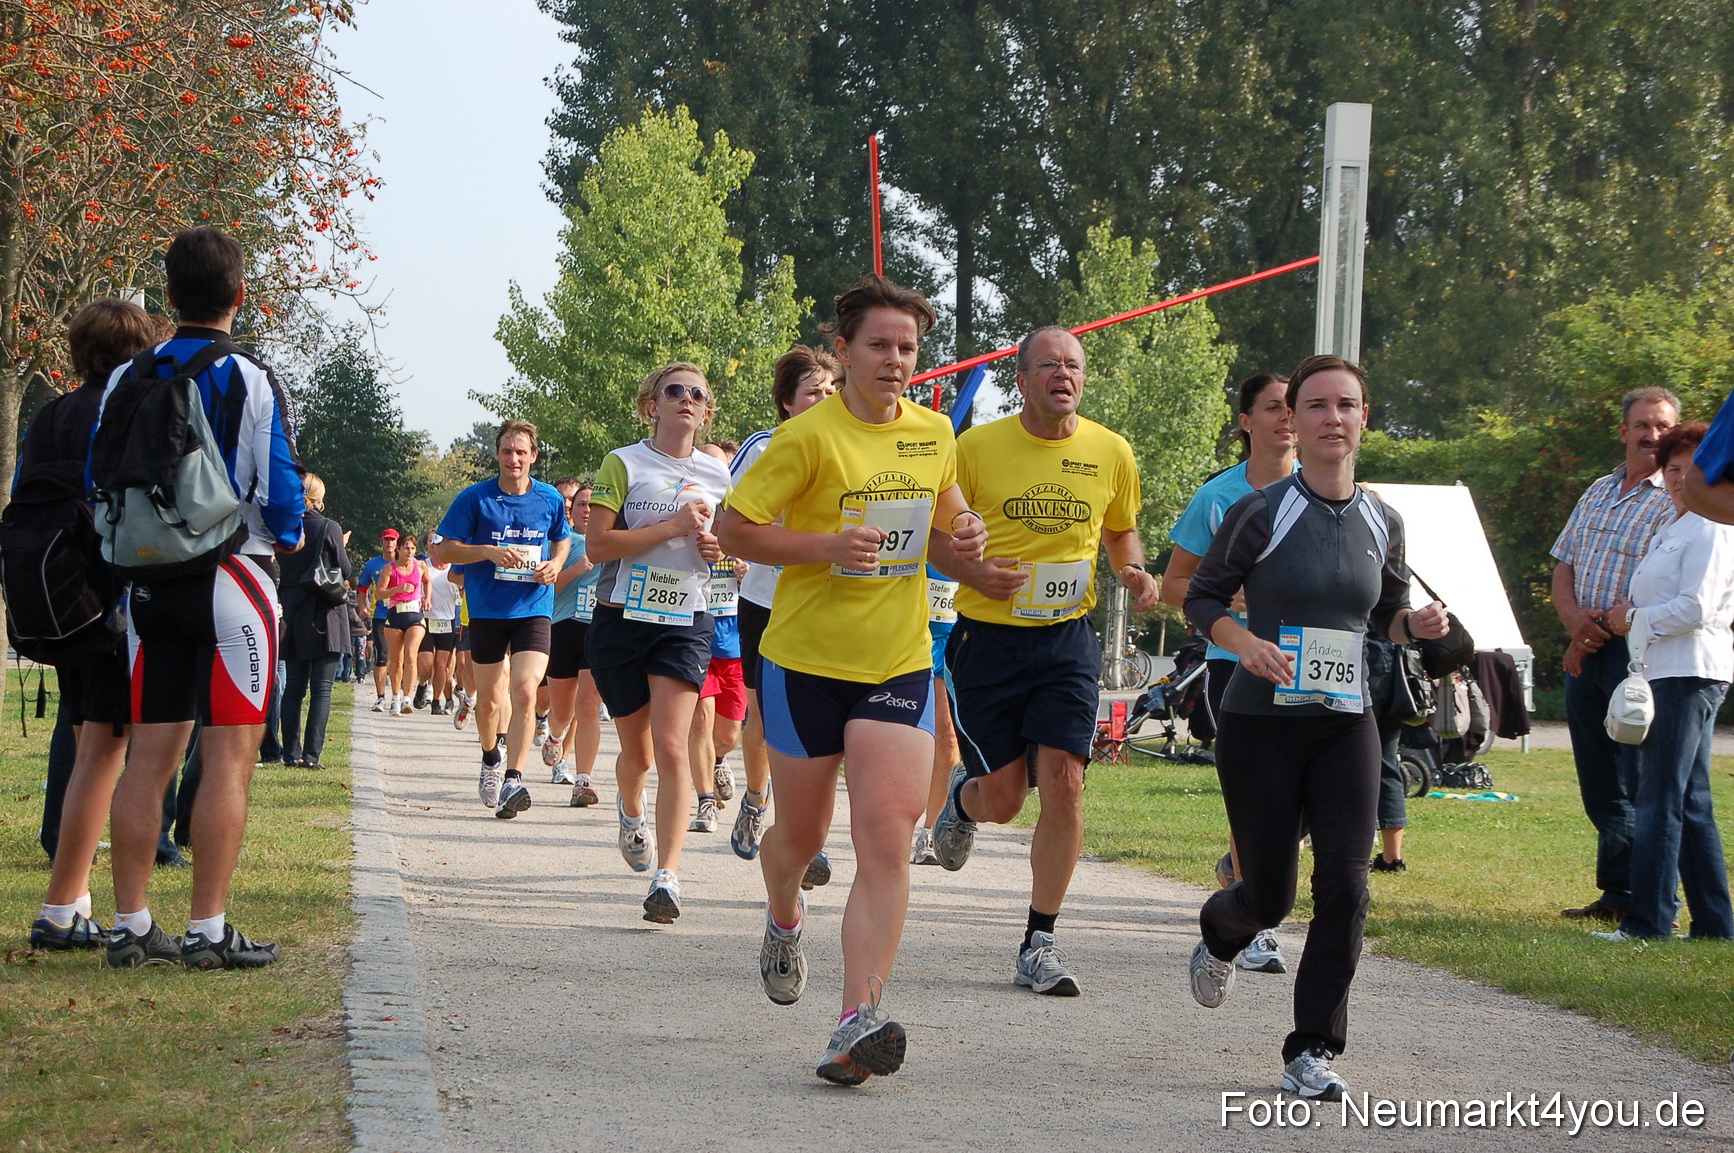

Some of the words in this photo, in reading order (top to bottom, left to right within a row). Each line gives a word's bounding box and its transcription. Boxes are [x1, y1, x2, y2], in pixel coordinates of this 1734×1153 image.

[866, 474, 917, 492] PIZZERIA
[1024, 486, 1074, 501] PIZZERIA
[626, 500, 679, 513] metropol
[1014, 500, 1083, 518] FRANCESCO
[513, 560, 537, 571] 049
[889, 562, 919, 572] PFLEIDERER
[650, 571, 680, 586] Niebler
[632, 584, 638, 592] C
[1045, 579, 1077, 599] 991
[646, 588, 689, 607] 2887
[1306, 639, 1343, 659] Andrea
[241, 624, 260, 694] Giordana
[1308, 659, 1355, 685] 3795
[885, 697, 918, 710] asics
